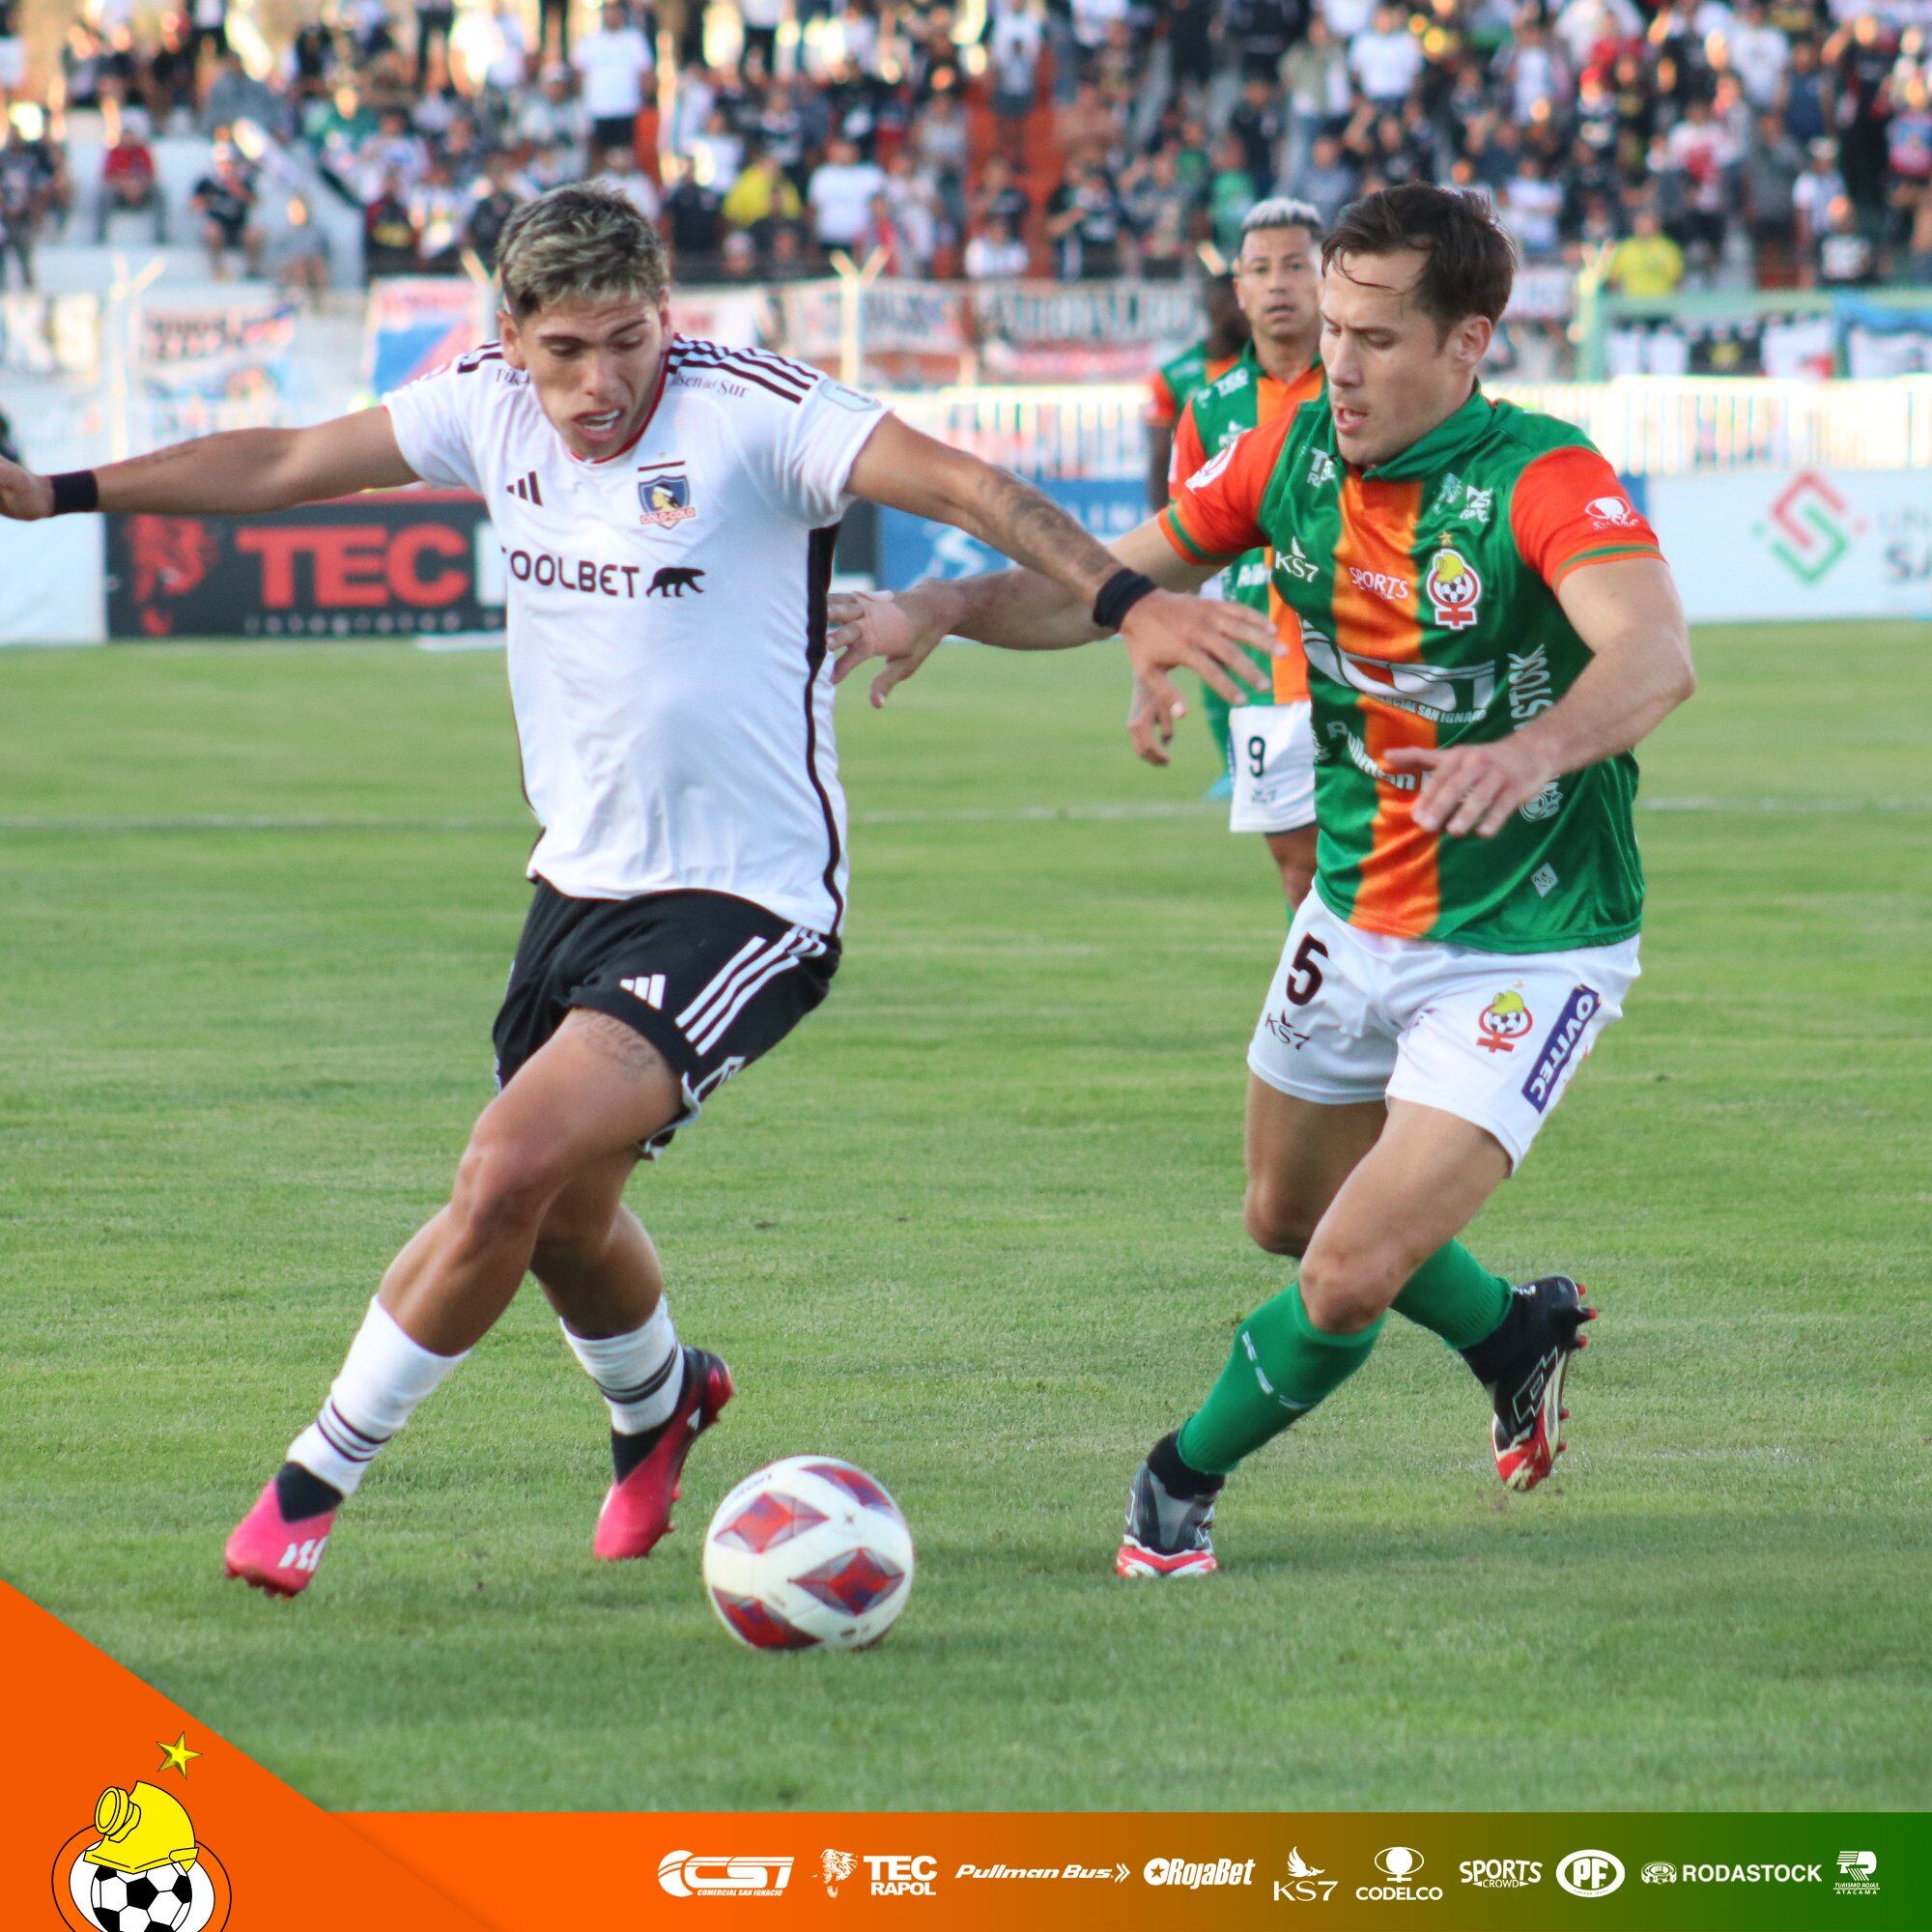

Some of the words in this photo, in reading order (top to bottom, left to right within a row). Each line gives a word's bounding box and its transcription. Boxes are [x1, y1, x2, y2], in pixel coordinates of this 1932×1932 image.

[718, 380, 751, 398] Sur
[235, 523, 469, 609] TEC
[499, 545, 639, 599] OOLBET
[1275, 550, 1320, 583] KS7
[1349, 566, 1409, 599] SPORTS
[1248, 735, 1266, 779] 9
[1286, 931, 1329, 1007] 5
[1264, 1011, 1311, 1050] KS7
[1529, 993, 1595, 1102] OVITEC
